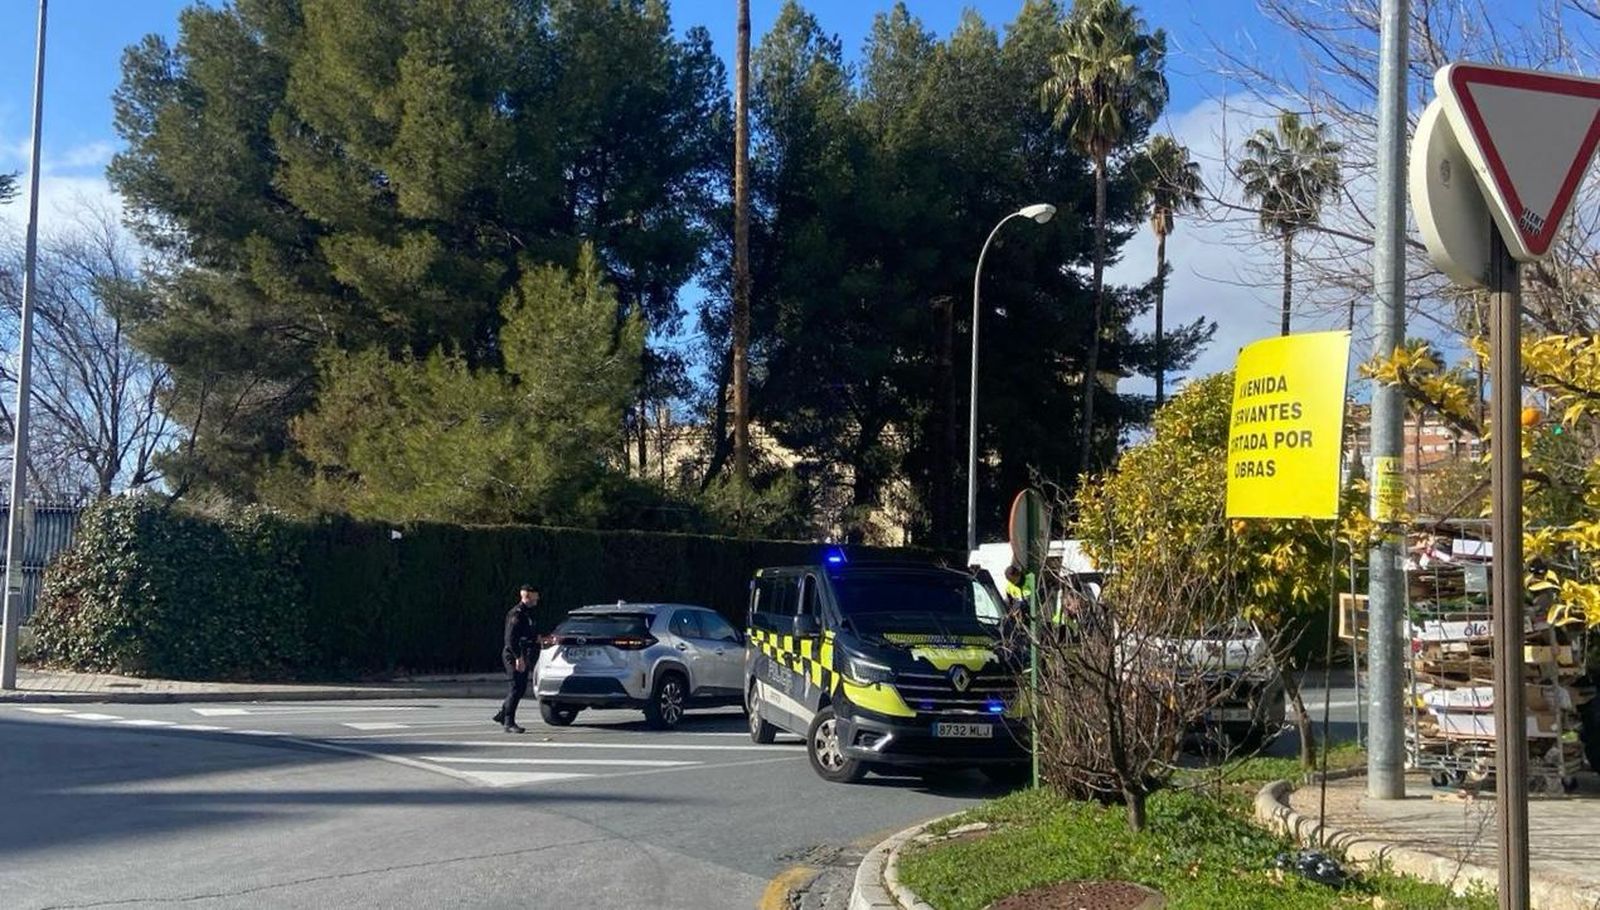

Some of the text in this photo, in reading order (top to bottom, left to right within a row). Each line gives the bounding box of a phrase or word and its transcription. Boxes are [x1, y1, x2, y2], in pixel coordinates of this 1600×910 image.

[1274, 429, 1314, 449] POR
[1235, 459, 1276, 479] OBRAS
[939, 724, 990, 737] 8732 MLJ
